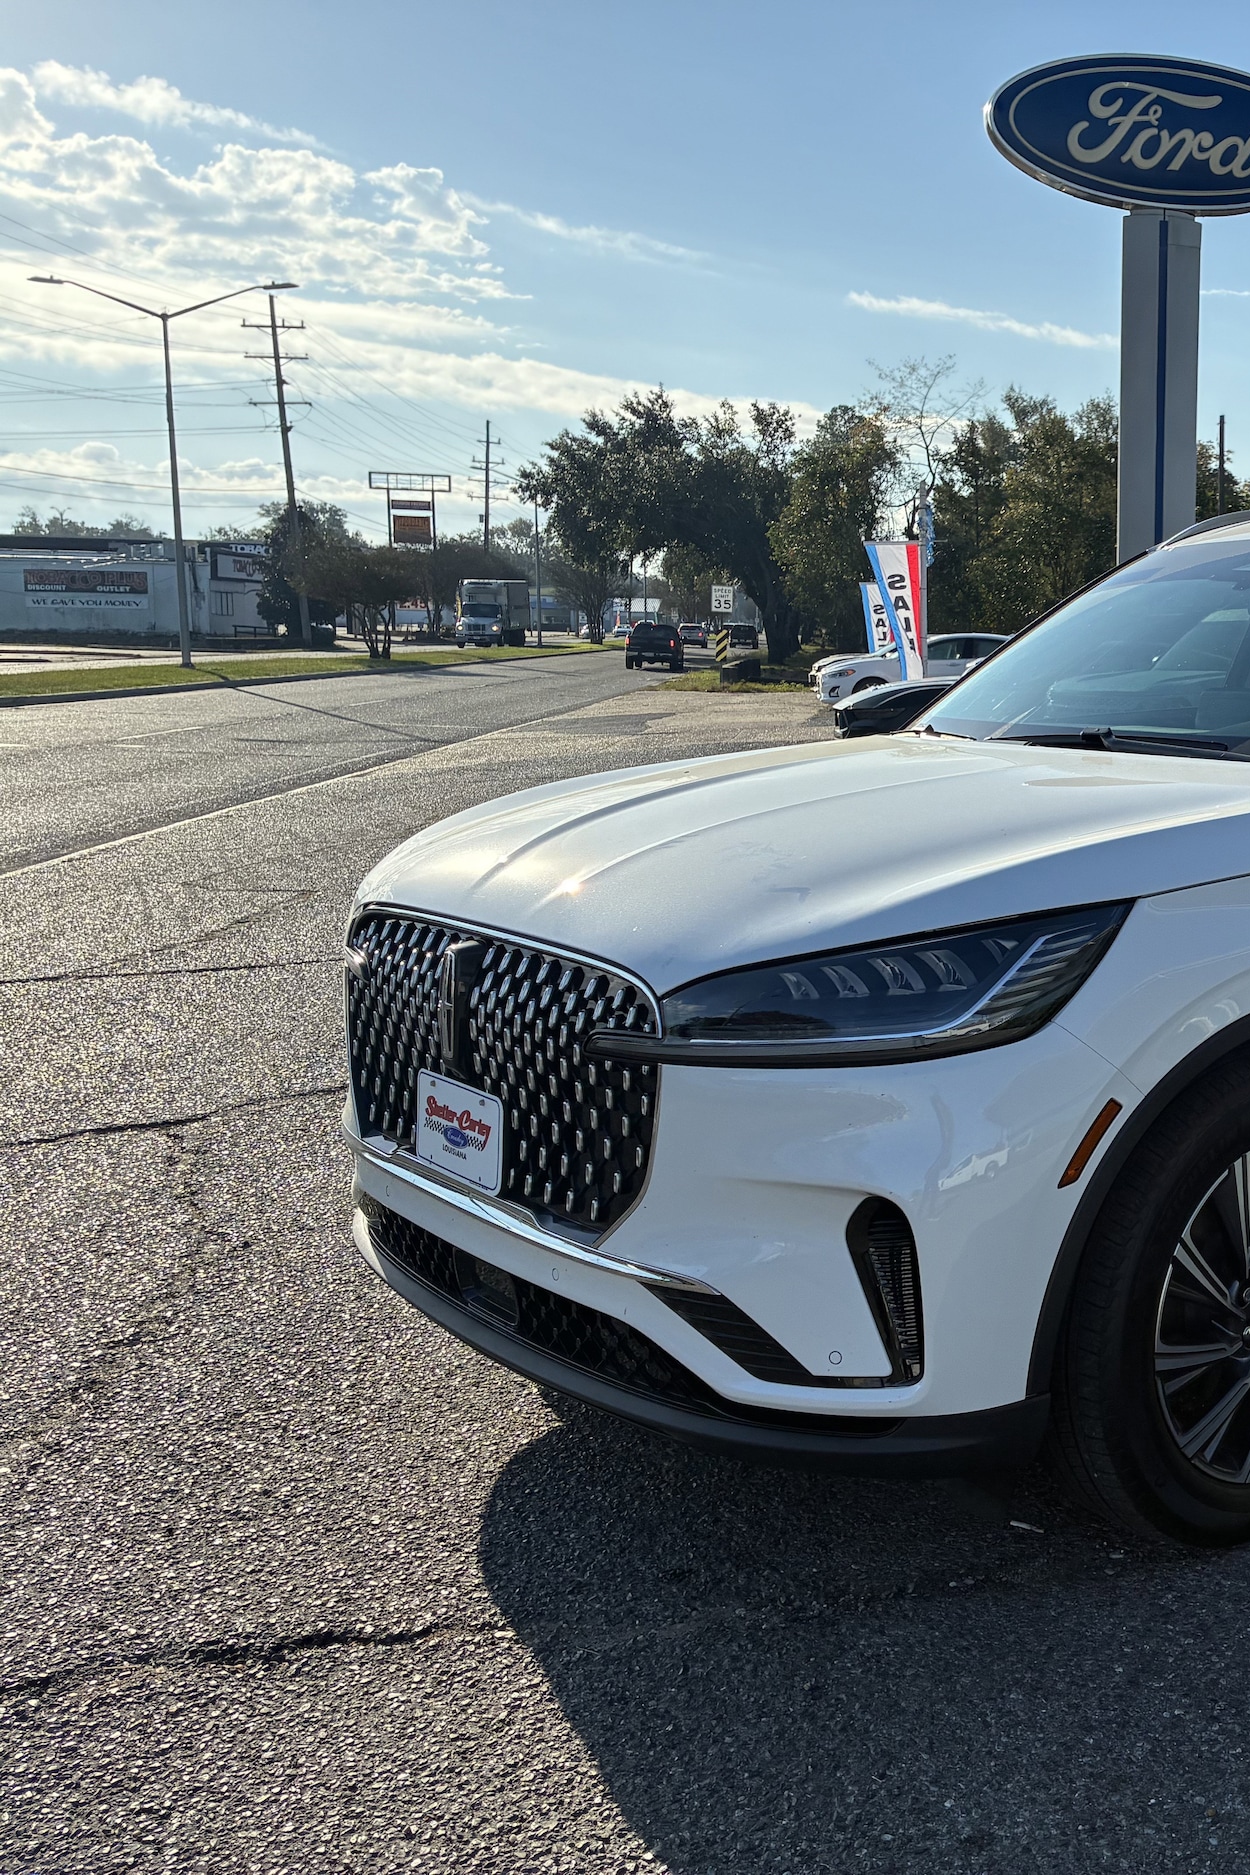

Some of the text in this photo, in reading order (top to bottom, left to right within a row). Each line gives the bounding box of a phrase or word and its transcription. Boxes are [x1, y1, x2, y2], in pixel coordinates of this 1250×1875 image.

[25, 570, 147, 590] TOBACCO PLUS
[27, 583, 131, 593] DISCOUNT OUTLET
[78, 599, 102, 607] YOU
[104, 599, 143, 607] MONEY
[713, 599, 732, 609] 35
[425, 1096, 492, 1152] Shetler-Corley
[442, 1144, 467, 1161] LOUISIANA
